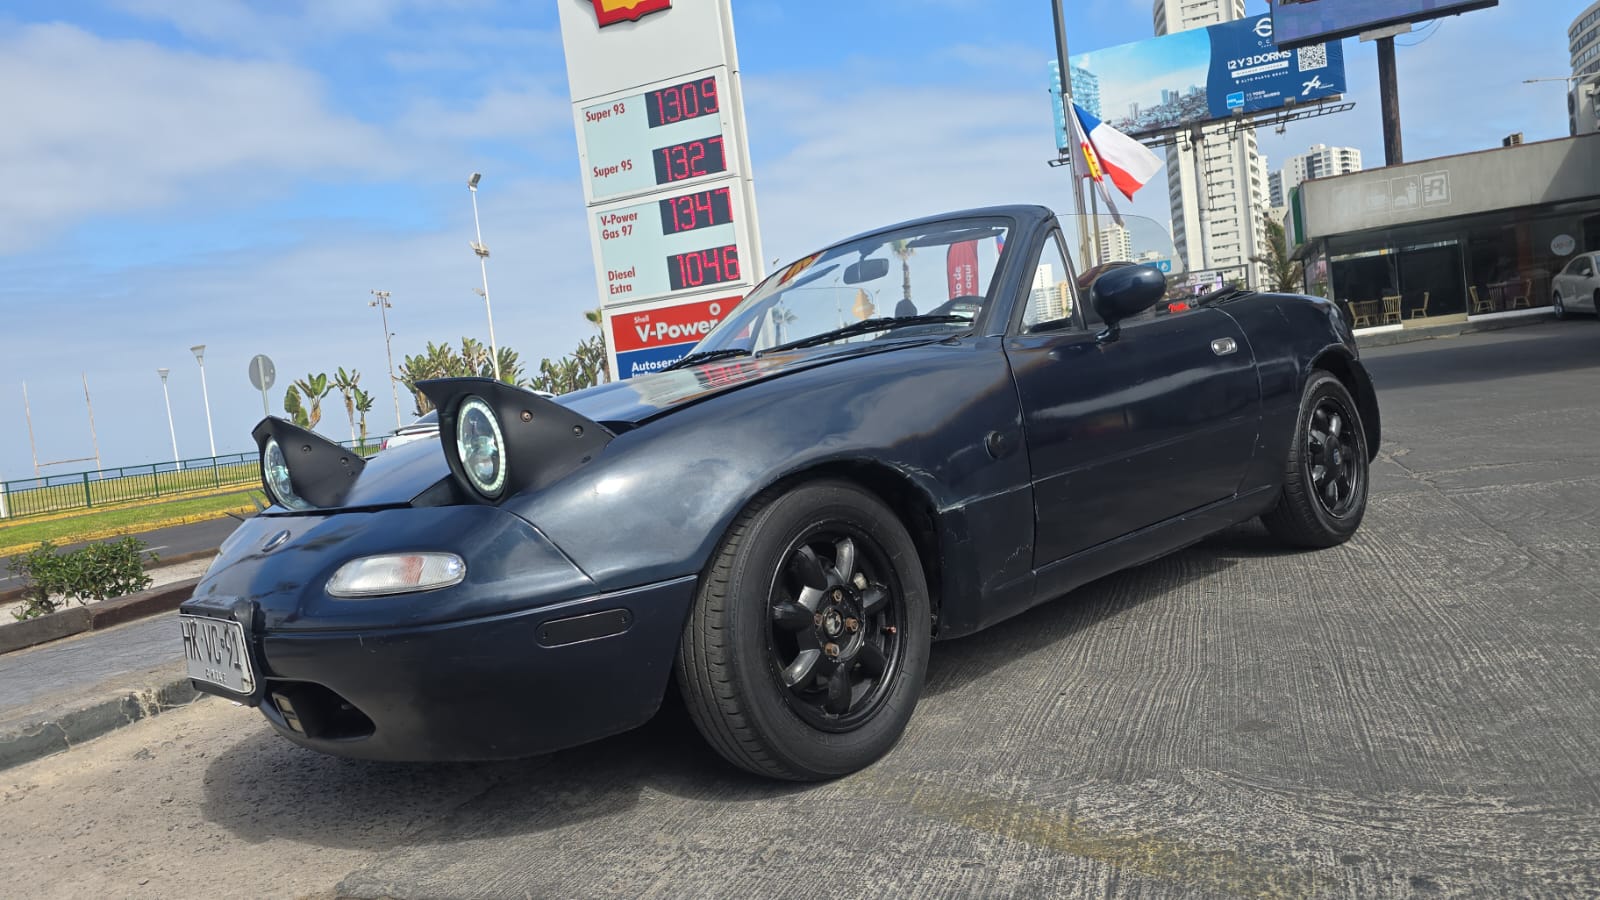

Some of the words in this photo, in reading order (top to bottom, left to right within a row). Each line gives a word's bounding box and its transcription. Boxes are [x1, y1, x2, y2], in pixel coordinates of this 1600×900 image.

[1253, 50, 1292, 64] DORMS
[655, 79, 719, 125] 1309
[585, 109, 612, 122] Super
[613, 103, 625, 115] 93
[662, 137, 727, 182] 1327
[593, 166, 619, 179] Super
[620, 159, 633, 171] 95
[669, 187, 734, 232] 1347
[600, 212, 638, 226] V-Power
[602, 228, 620, 240] Gas
[621, 225, 633, 236] 97
[608, 266, 636, 282] Diesel
[676, 246, 741, 288] 1046
[609, 284, 633, 295] Extra
[634, 315, 650, 324] Shell
[635, 320, 719, 343] V-Power
[631, 355, 683, 372] Autoservi
